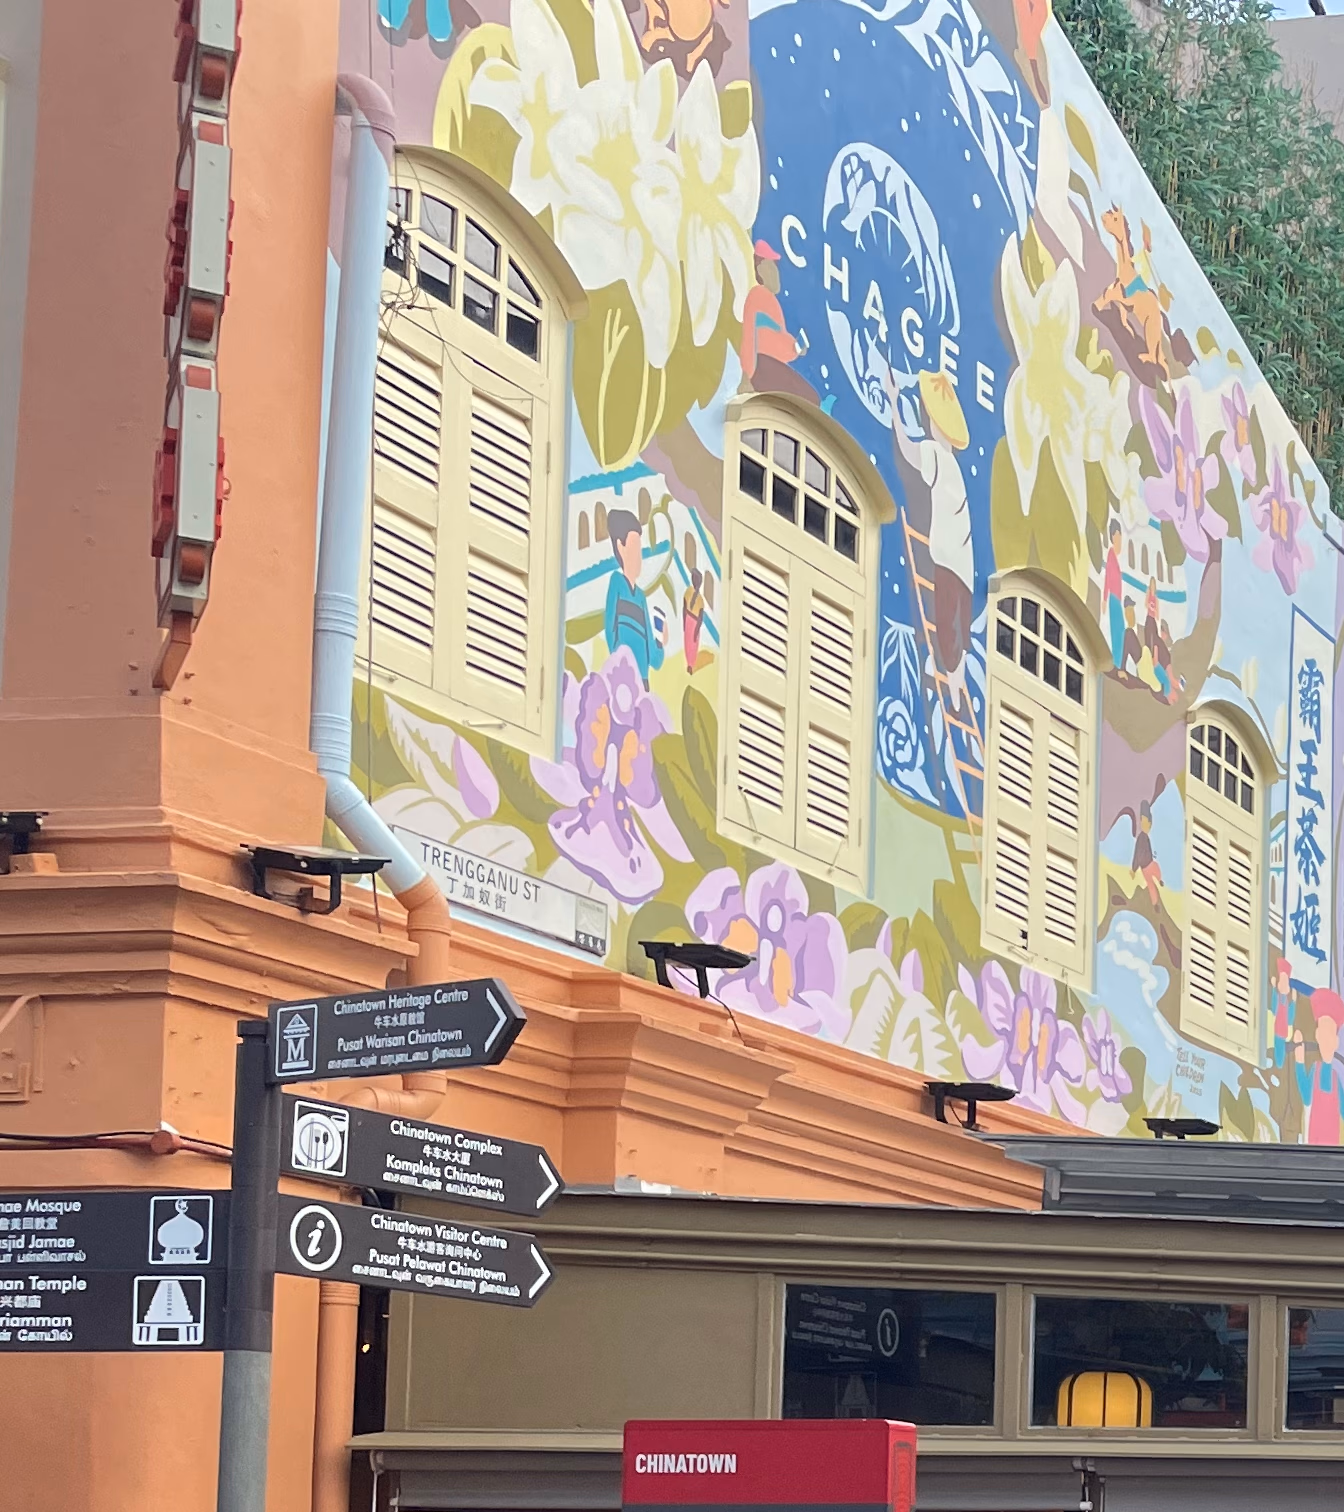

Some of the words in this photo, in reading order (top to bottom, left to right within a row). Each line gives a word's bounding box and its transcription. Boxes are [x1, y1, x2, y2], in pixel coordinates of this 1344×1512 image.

[781, 215, 994, 412] CHAGEE
[1289, 659, 1327, 964] 霸王茶姬
[420, 842, 519, 895] TRENGGANU
[523, 880, 541, 903] ST
[446, 876, 507, 912] 丁加奴街
[334, 1000, 386, 1015] Chinatown
[388, 993, 431, 1010] Heritage
[434, 988, 469, 1004] Centre
[337, 1036, 364, 1052] Pusat
[365, 1033, 406, 1049] Warisan
[407, 1028, 462, 1045] Chinatown
[390, 1119, 452, 1146] Chinatown
[454, 1134, 504, 1156] Complex
[386, 1154, 442, 1179] Kompleks
[444, 1165, 504, 1189] Chinatown
[25, 1198, 82, 1215] Mosque
[28, 1235, 75, 1248] Jamae
[370, 1214, 433, 1237] Chinatown
[434, 1224, 470, 1243] Visitor
[471, 1230, 508, 1249] Centre
[368, 1249, 401, 1267] Pusat
[402, 1254, 447, 1274] Pelawat
[448, 1261, 506, 1283] Chinatown
[28, 1276, 87, 1294] Temple
[635, 1453, 737, 1474] CHINATOWN
